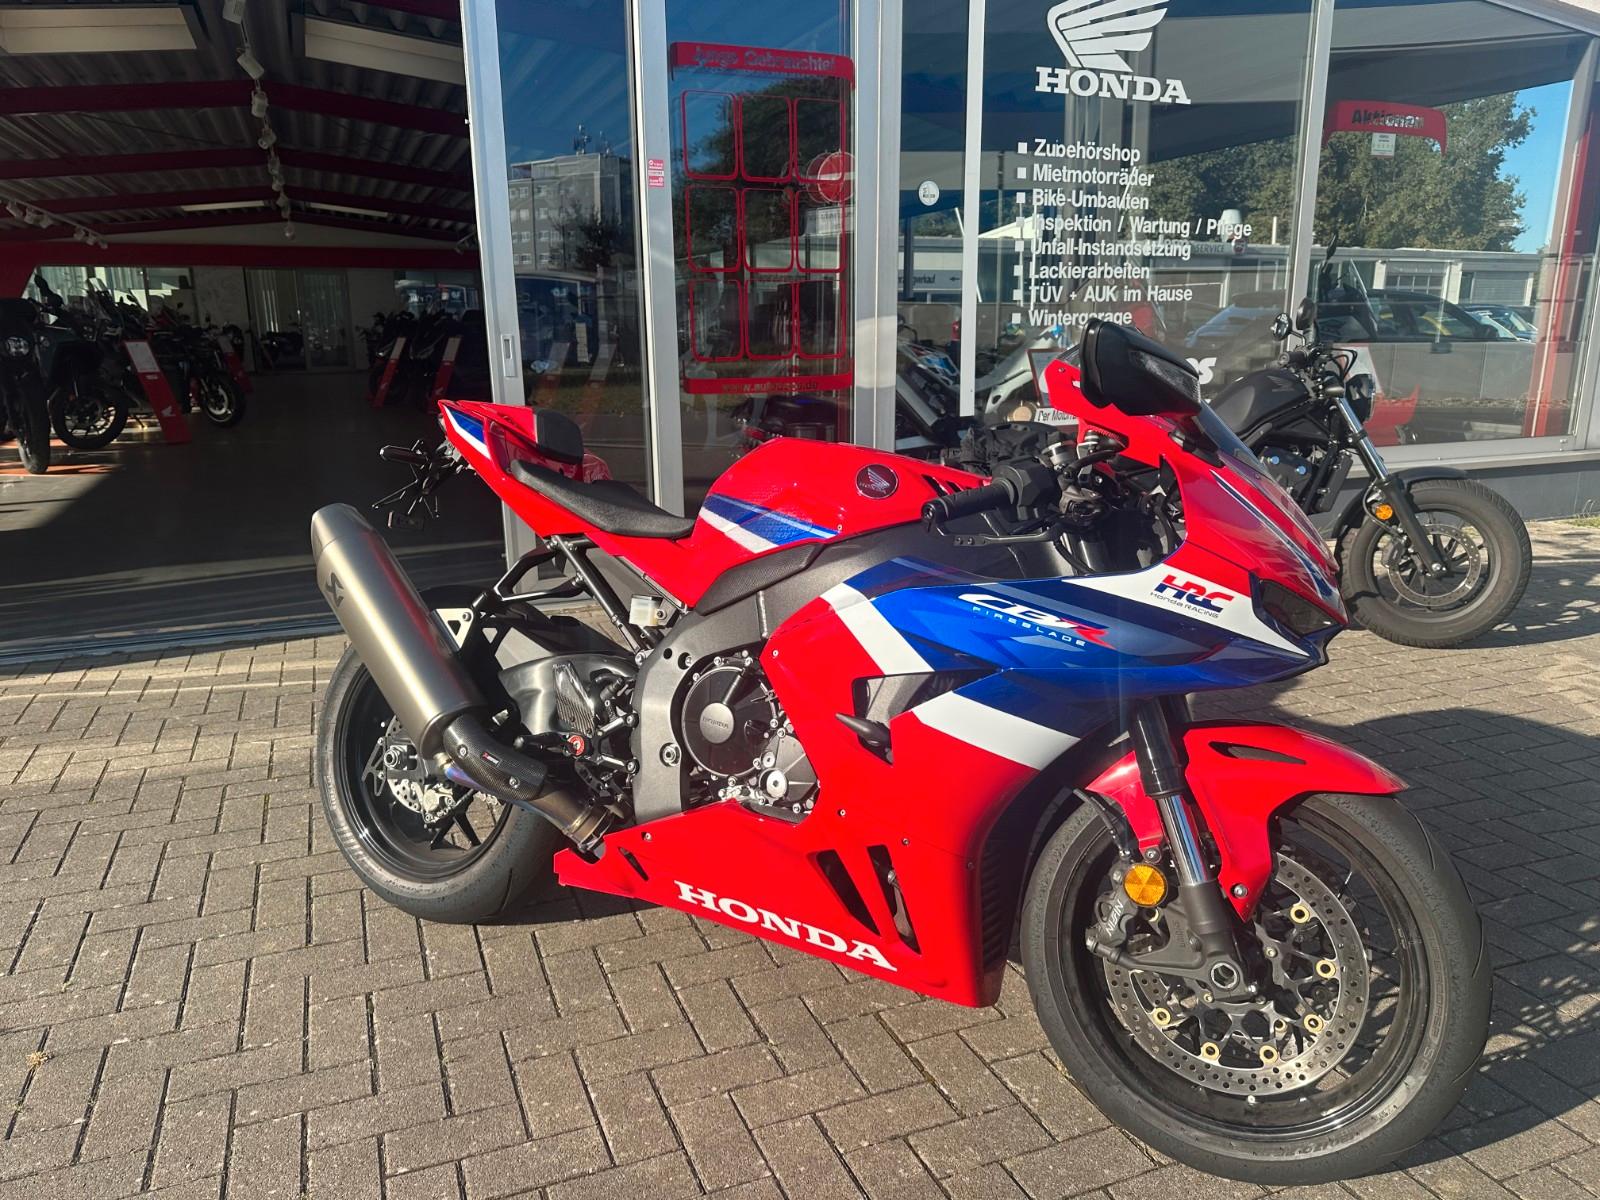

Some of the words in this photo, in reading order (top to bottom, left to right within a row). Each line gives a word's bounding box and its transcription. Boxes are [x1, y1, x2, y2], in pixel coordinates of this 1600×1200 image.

[1035, 66, 1191, 104] HONDA
[1034, 138, 1140, 166] Zubehörshop
[1033, 164, 1154, 186] Mietmotorräder
[1032, 188, 1149, 210] Bike-Umbauten
[1130, 216, 1190, 237] Wartung
[1207, 219, 1252, 239] Pflege
[1031, 238, 1191, 260] Unfall-Instandsetzung
[1029, 261, 1150, 280] Lackierarbeiten
[1029, 284, 1063, 303] TÜV
[1084, 285, 1117, 302] AUK
[1124, 285, 1141, 302] im
[1147, 285, 1193, 302] Hause
[1154, 574, 1234, 613] HRC
[958, 593, 1117, 650] CBR
[1185, 604, 1219, 618] RACING
[972, 606, 1086, 647] FIREBLADE
[674, 880, 897, 972] HONDA
